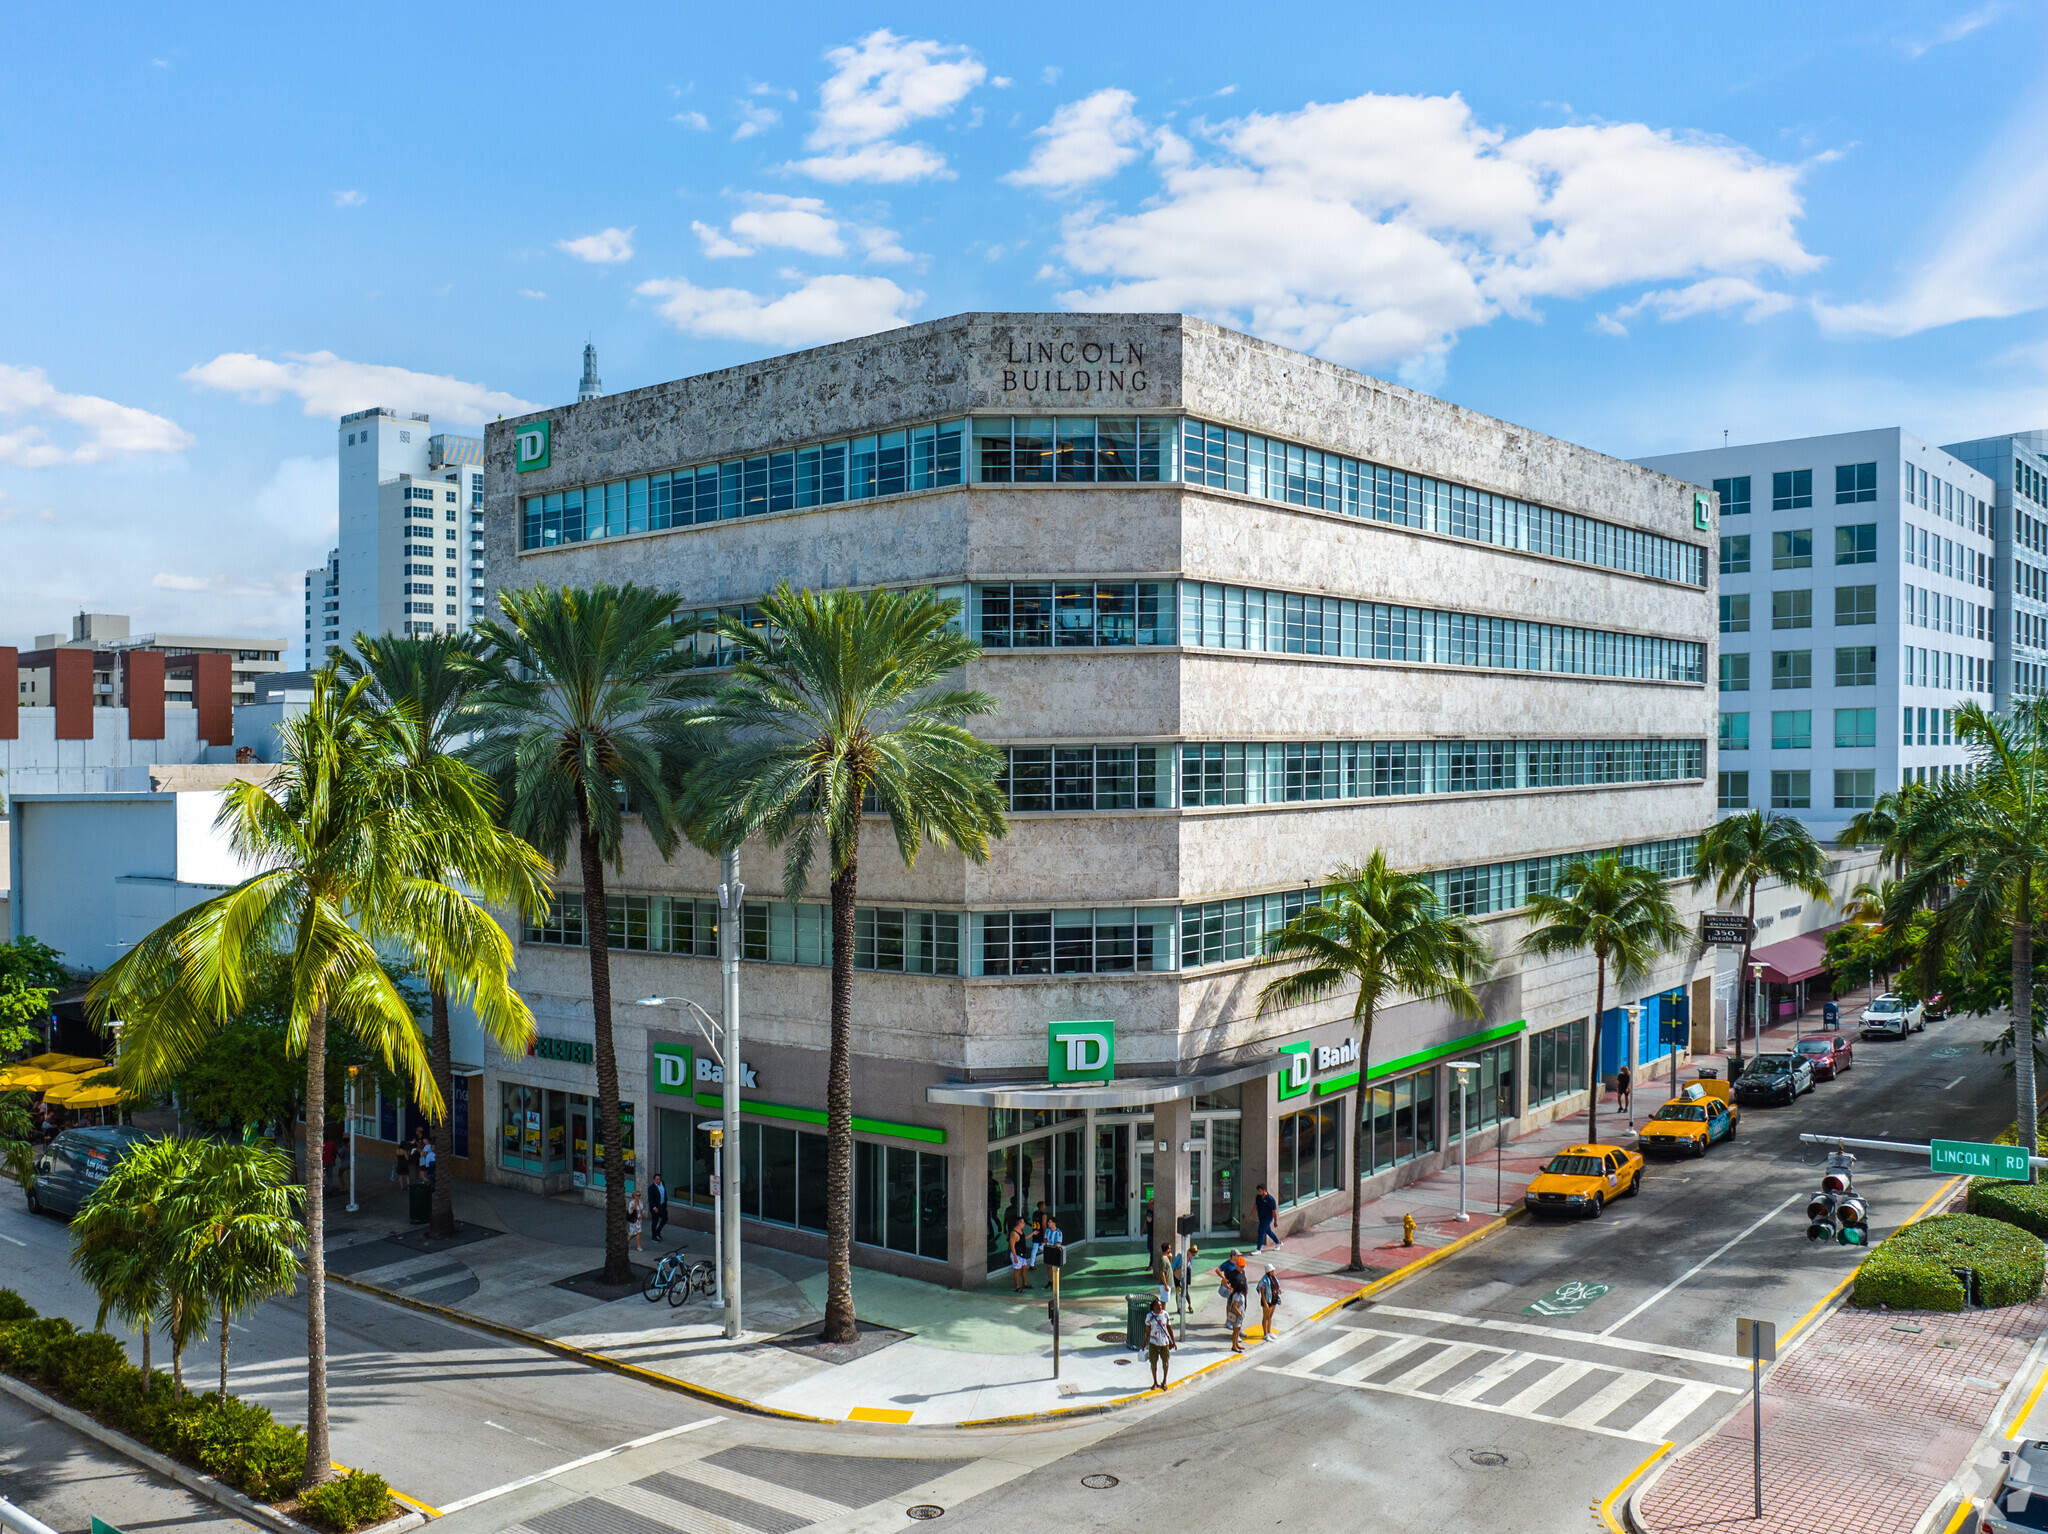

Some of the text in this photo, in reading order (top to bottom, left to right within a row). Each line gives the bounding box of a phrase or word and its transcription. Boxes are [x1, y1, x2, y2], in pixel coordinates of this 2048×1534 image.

[1008, 342, 1143, 364] LINCOLN
[1003, 370, 1147, 391] BUILDING
[516, 430, 545, 462] TD
[1698, 500, 1711, 522] TD
[1056, 1033, 1109, 1071] TD
[1290, 1038, 1360, 1087] TD Bank
[654, 1053, 758, 1089] TD Bak
[1936, 1149, 2024, 1169] LINCOLN RD
